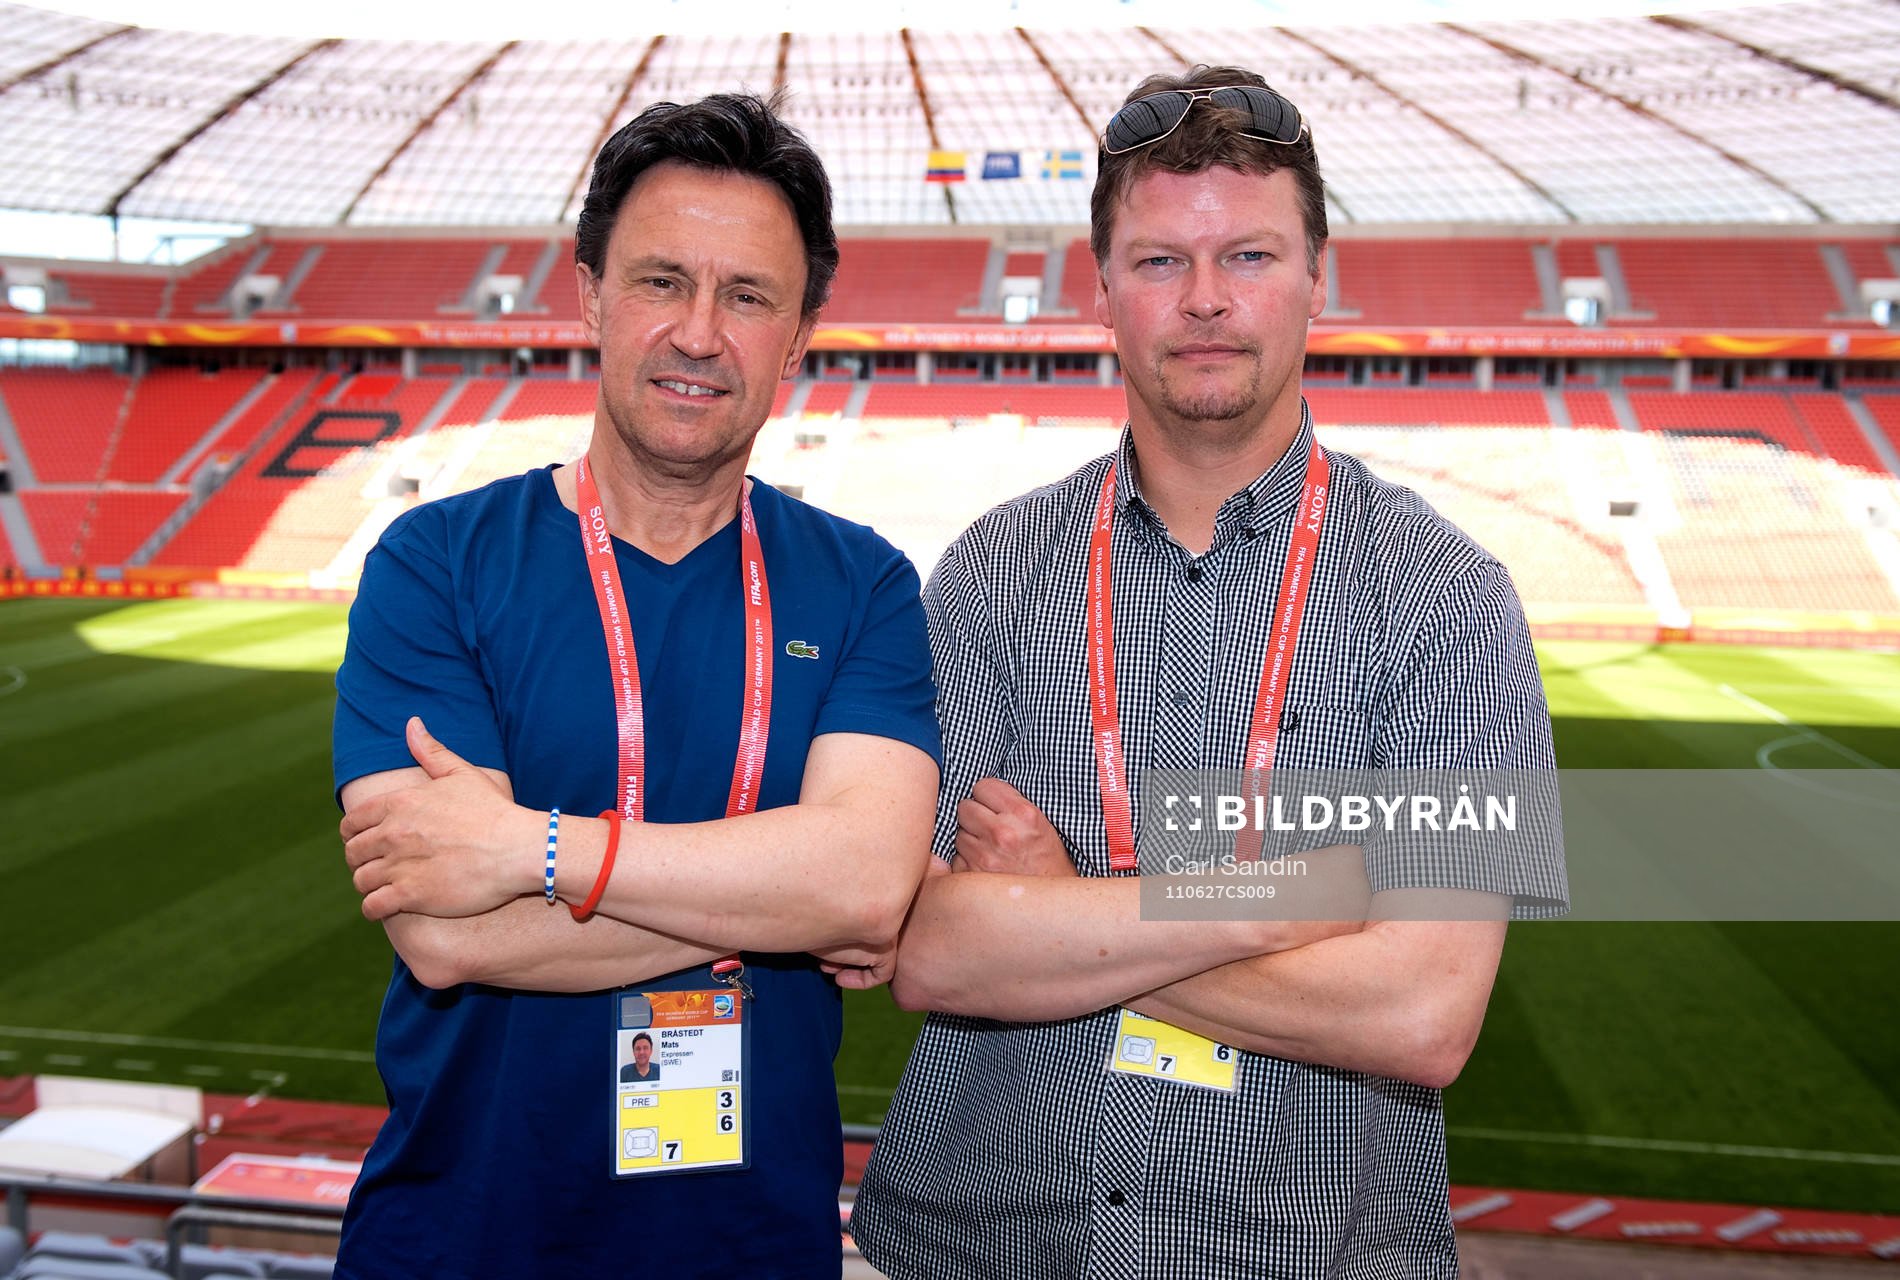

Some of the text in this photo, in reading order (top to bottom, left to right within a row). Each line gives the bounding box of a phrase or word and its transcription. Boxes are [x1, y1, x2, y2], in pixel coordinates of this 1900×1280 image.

[1101, 483, 1114, 531] SONY
[1307, 485, 1326, 535] SONY
[590, 505, 611, 555] SONY
[1296, 546, 1306, 562] FIFA
[601, 571, 611, 585] FIFA
[1095, 563, 1103, 599] WOMEN'S
[1287, 563, 1302, 603] WOMEN'S
[605, 586, 620, 624] WOMEN'S
[1095, 600, 1103, 630] WORLD
[1281, 603, 1294, 633] WORLD
[613, 625, 626, 657] WORLD
[1277, 634, 1287, 651] CUP
[619, 658, 628, 676] CUP
[755, 645, 763, 687] GERMANY
[1096, 647, 1106, 687] GERMANY
[1271, 651, 1283, 693] GERMANY
[754, 689, 762, 707] CUP
[750, 709, 761, 742] WORLD
[742, 745, 756, 790] WOMEN'S
[738, 792, 748, 811] FIFA
[1160, 1056, 1173, 1072] 7
[1217, 1045, 1230, 1060] 6
[631, 1097, 650, 1107] PRE
[720, 1091, 732, 1108] 3
[720, 1115, 733, 1131] 6
[665, 1143, 678, 1159] 7
